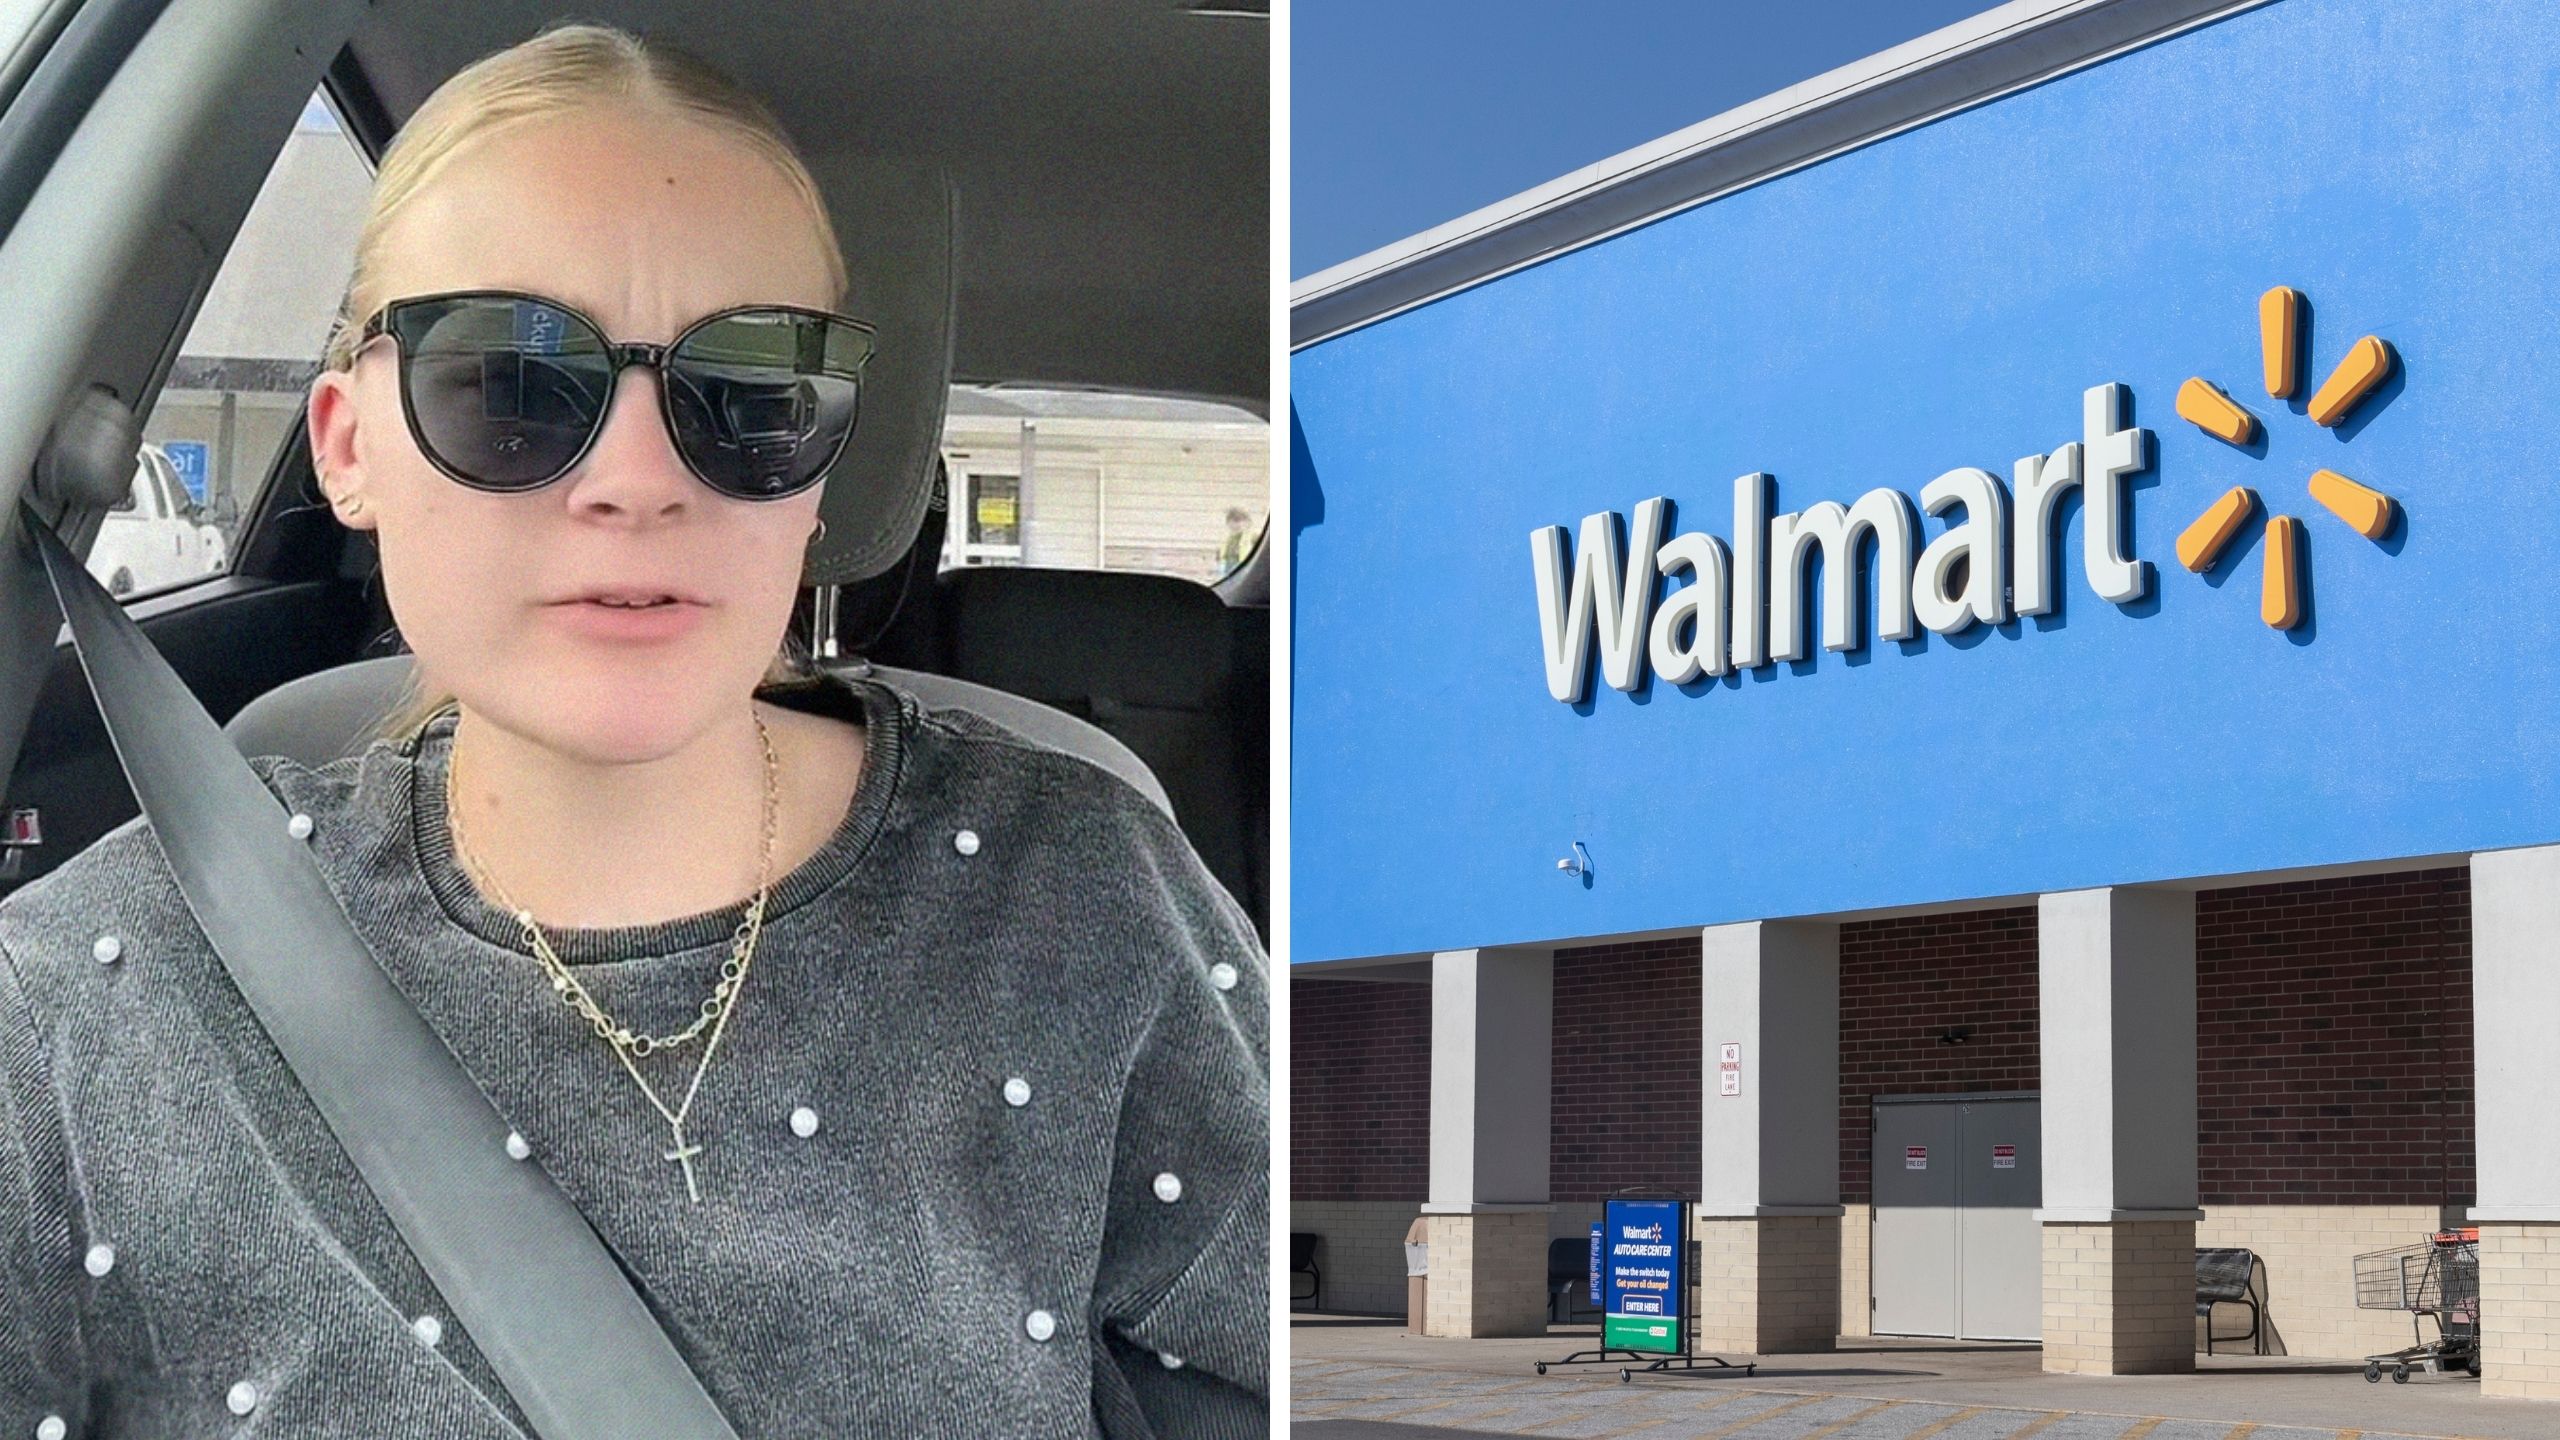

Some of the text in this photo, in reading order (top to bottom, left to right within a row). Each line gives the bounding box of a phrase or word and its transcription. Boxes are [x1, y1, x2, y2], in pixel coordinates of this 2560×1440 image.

[1529, 381, 2145, 704] Walmart
[1726, 1048, 1735, 1059] NO
[1721, 1062, 1740, 1071] PARKING
[1725, 1073, 1735, 1081] FIRE
[1622, 1226, 1651, 1239] Walmart
[1613, 1244, 1671, 1256] AUTO CARE CENTER
[1615, 1267, 1670, 1280] Make the switch today
[1616, 1279, 1626, 1288] Get
[1627, 1281, 1639, 1290] your
[1647, 1280, 1669, 1291] changed
[1625, 1301, 1660, 1312] ENTER HERE
